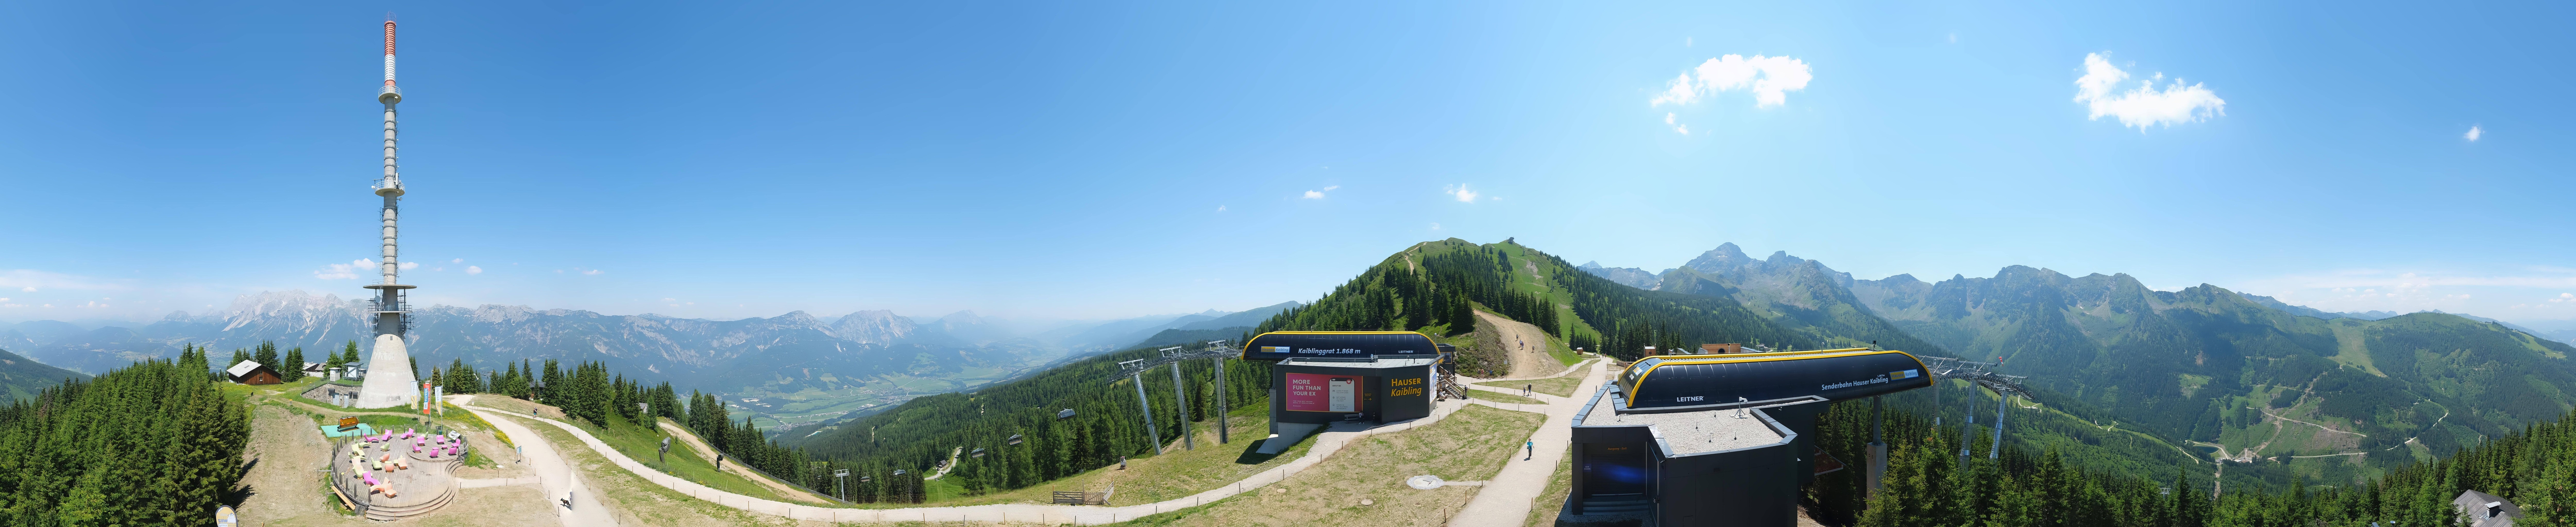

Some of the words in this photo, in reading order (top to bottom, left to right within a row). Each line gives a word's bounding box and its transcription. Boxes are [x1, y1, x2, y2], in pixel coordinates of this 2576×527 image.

[1392, 378, 1421, 387] HAUSER
[1822, 381, 1852, 390] Senderbahn
[1391, 387, 1421, 396] Kaibling
